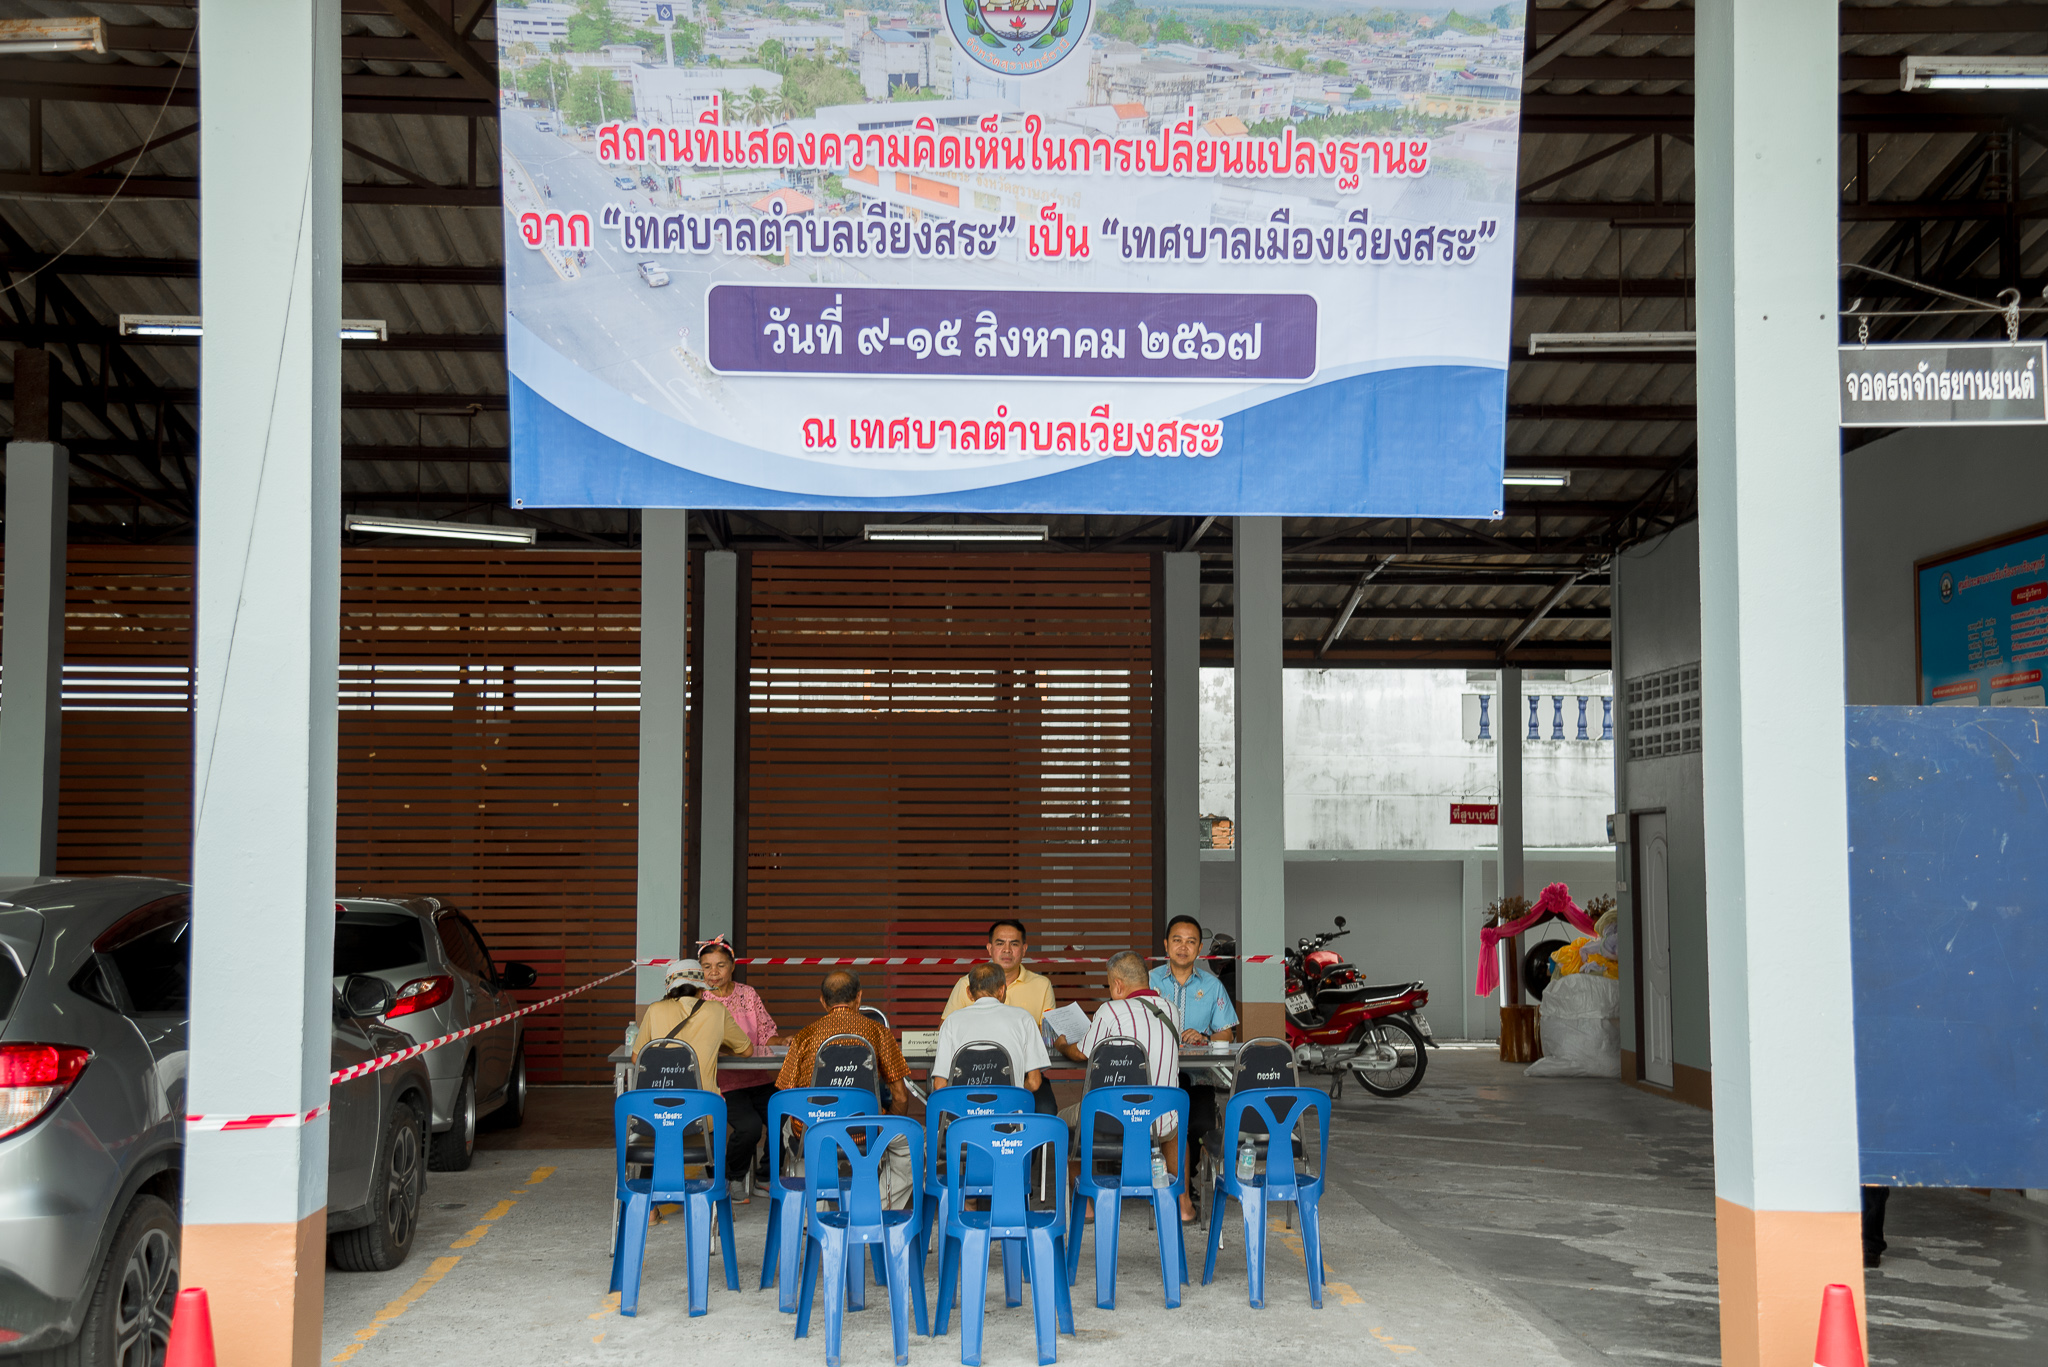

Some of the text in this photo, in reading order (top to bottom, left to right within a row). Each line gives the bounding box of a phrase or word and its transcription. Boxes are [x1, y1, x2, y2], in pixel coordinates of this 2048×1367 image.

[599, 95, 1428, 188] สถานที่แสดงความคิดเห็นในการเปลี่ยนแปลงฐานะ
[520, 212, 589, 246] จาก
[1029, 203, 1090, 257] เป็น
[763, 293, 1262, 360] วันที่ ๙-๑๕ สิงหาคม ๒๕๖๗
[1846, 357, 2035, 401] จอดรถจักรยานยนต์
[802, 404, 1219, 454] ณ เทศบาลตำบลเวียงสระ
